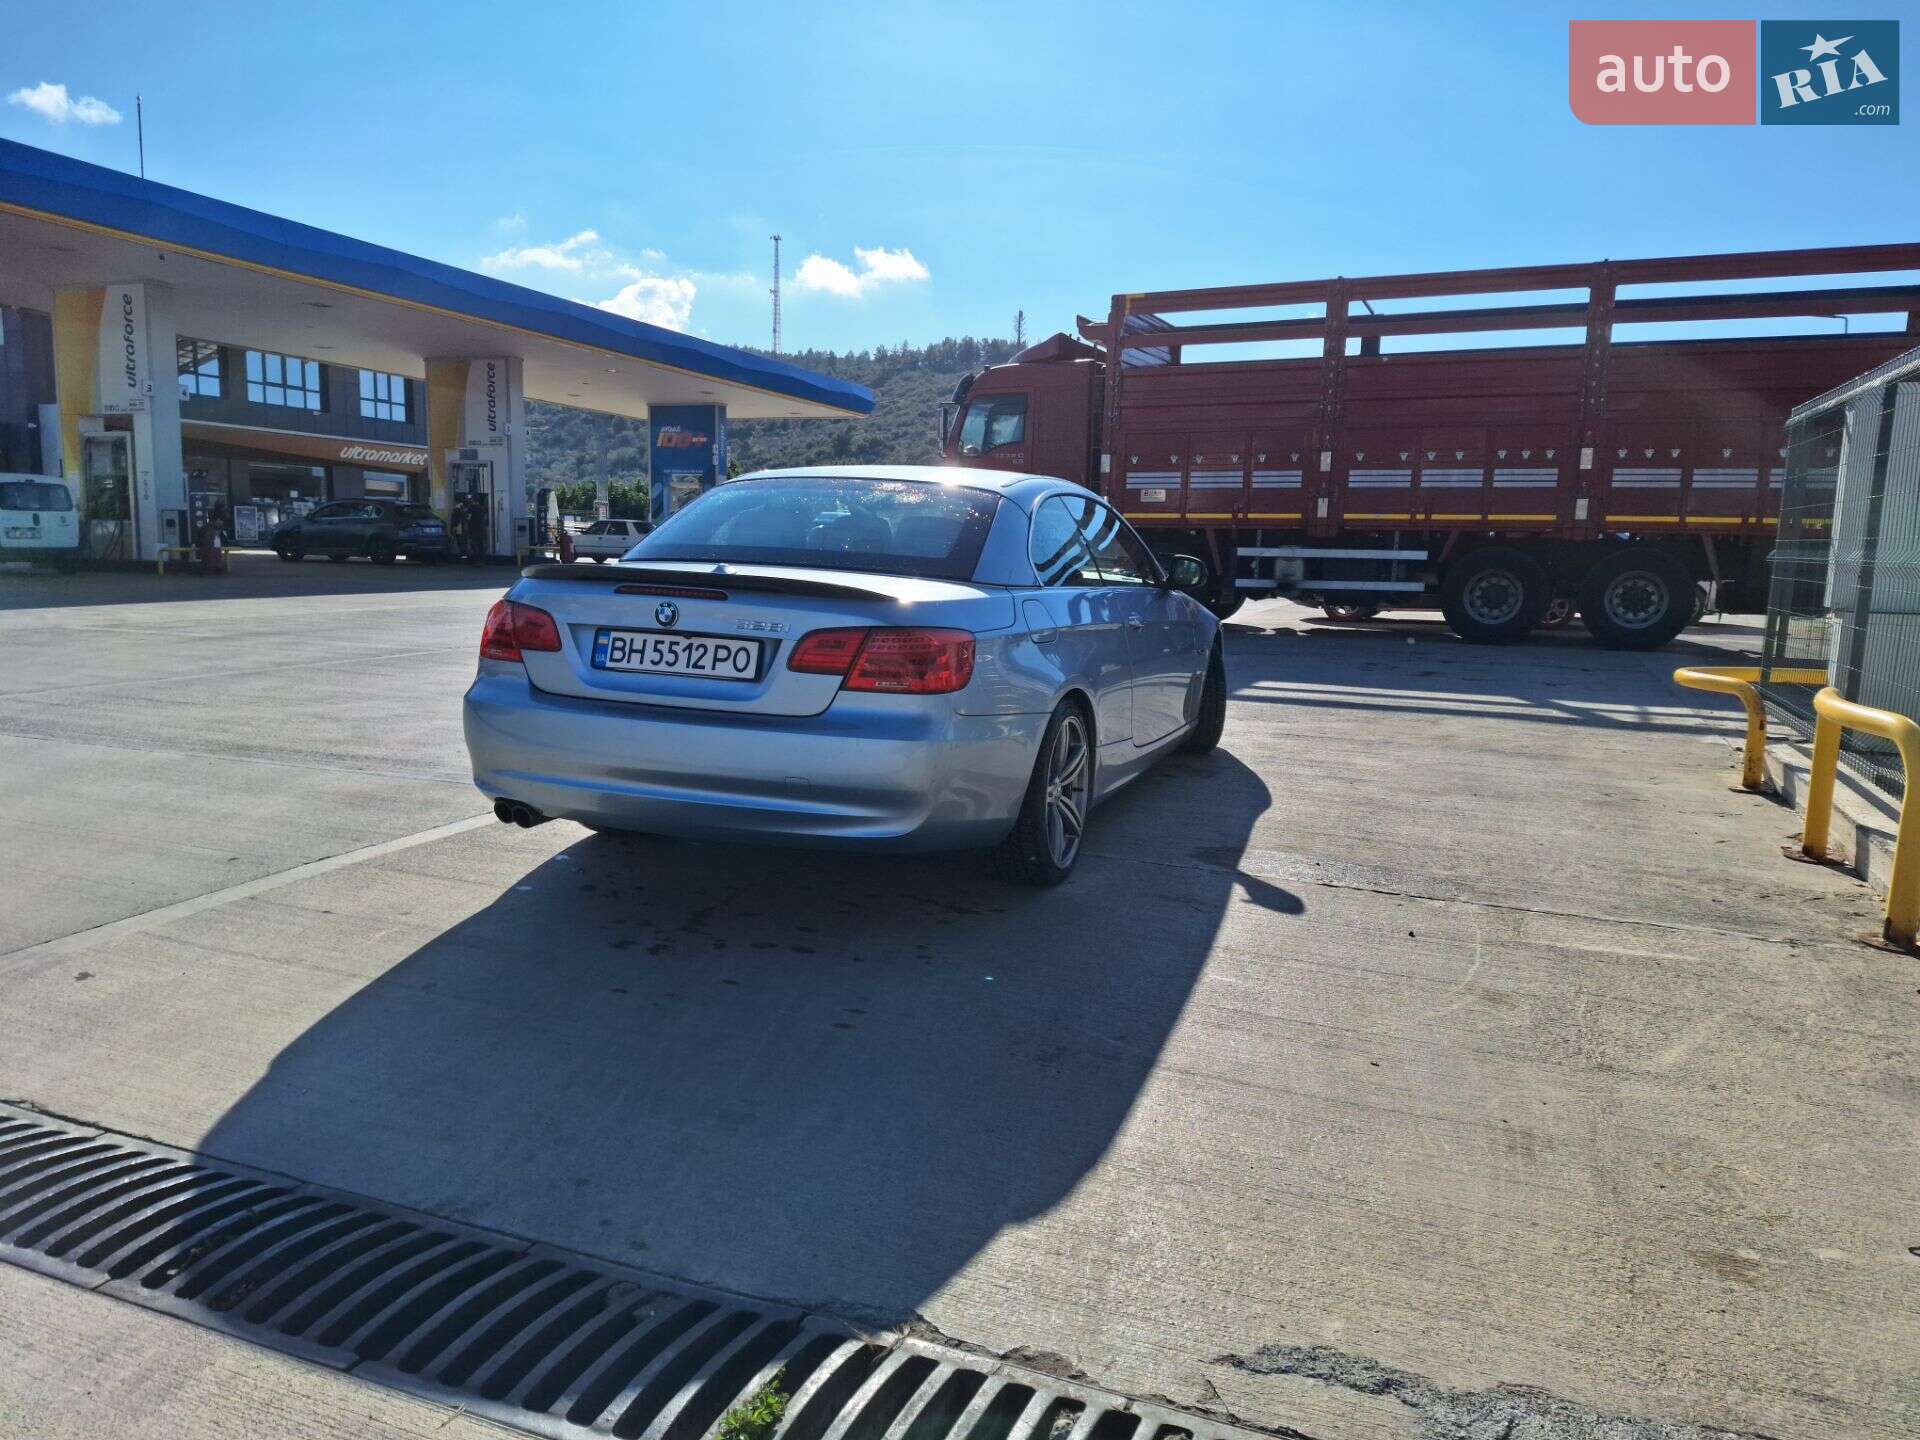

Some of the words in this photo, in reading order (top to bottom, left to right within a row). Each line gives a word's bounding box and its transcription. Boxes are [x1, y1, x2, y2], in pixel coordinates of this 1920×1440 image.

[122, 293, 137, 388] ultraforce
[486, 361, 497, 432] ultraforce
[340, 445, 429, 465] ultramarket
[608, 636, 648, 665] BH
[650, 639, 707, 670] 5512
[711, 644, 751, 673] PO
